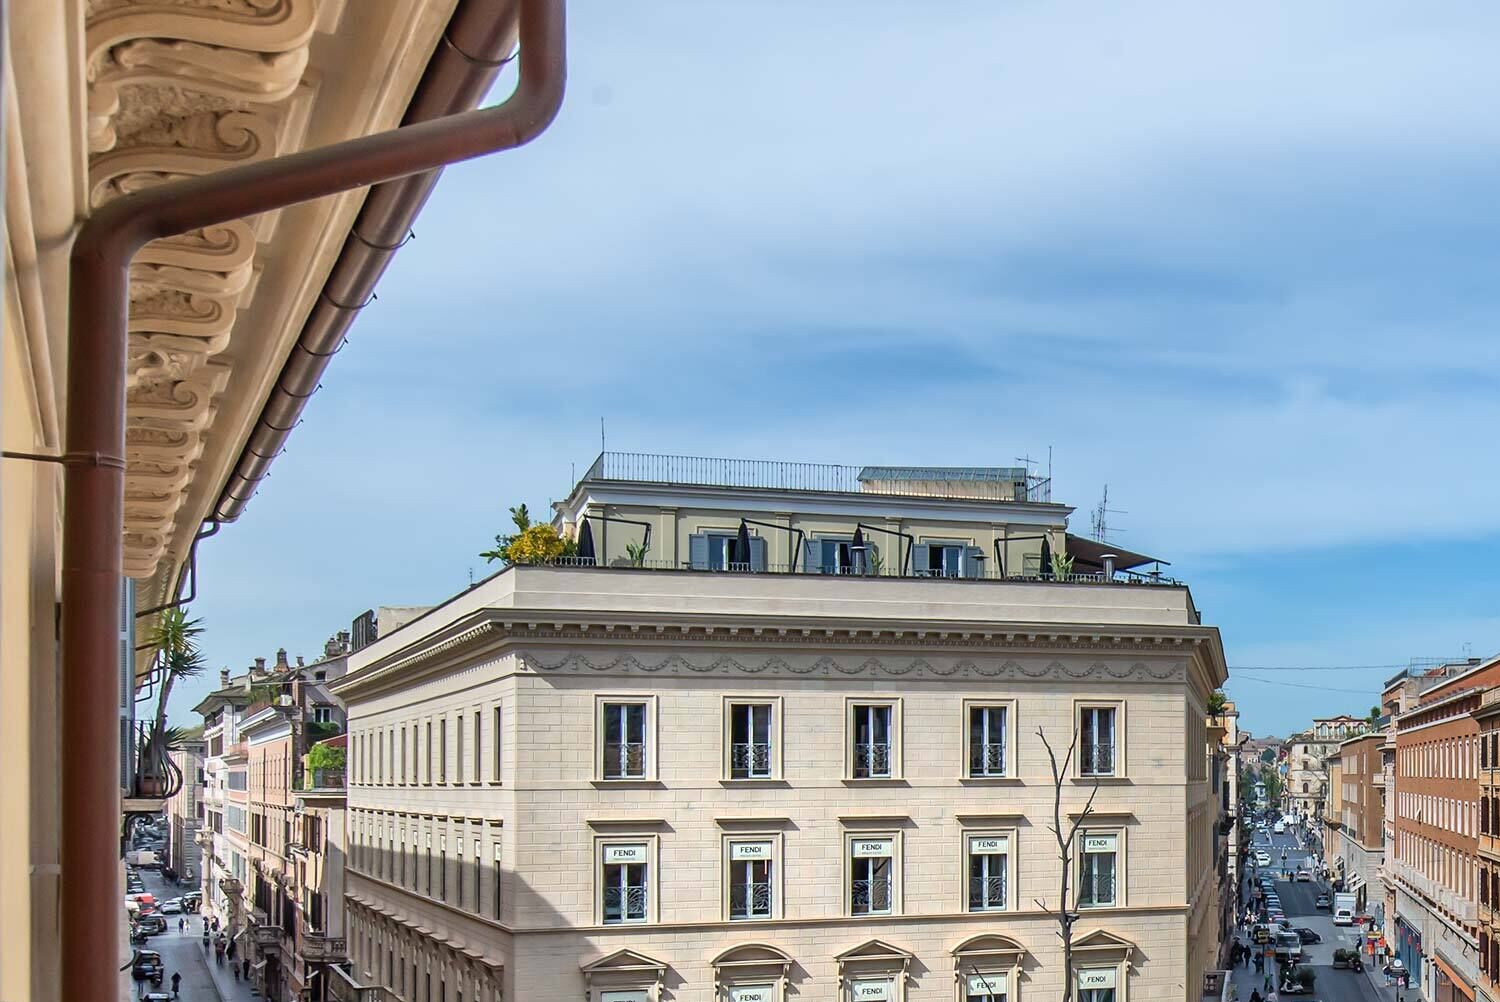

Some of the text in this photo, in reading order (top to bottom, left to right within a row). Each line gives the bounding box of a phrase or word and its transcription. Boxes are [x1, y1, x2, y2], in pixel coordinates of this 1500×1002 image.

[861, 843, 882, 851] FENDI
[977, 840, 998, 848] FENDI
[1088, 839, 1108, 847] FENDI
[613, 849, 636, 857] FENDI
[1087, 975, 1106, 983] FENDI
[976, 981, 997, 989] FENDI
[861, 987, 883, 995] FENDI
